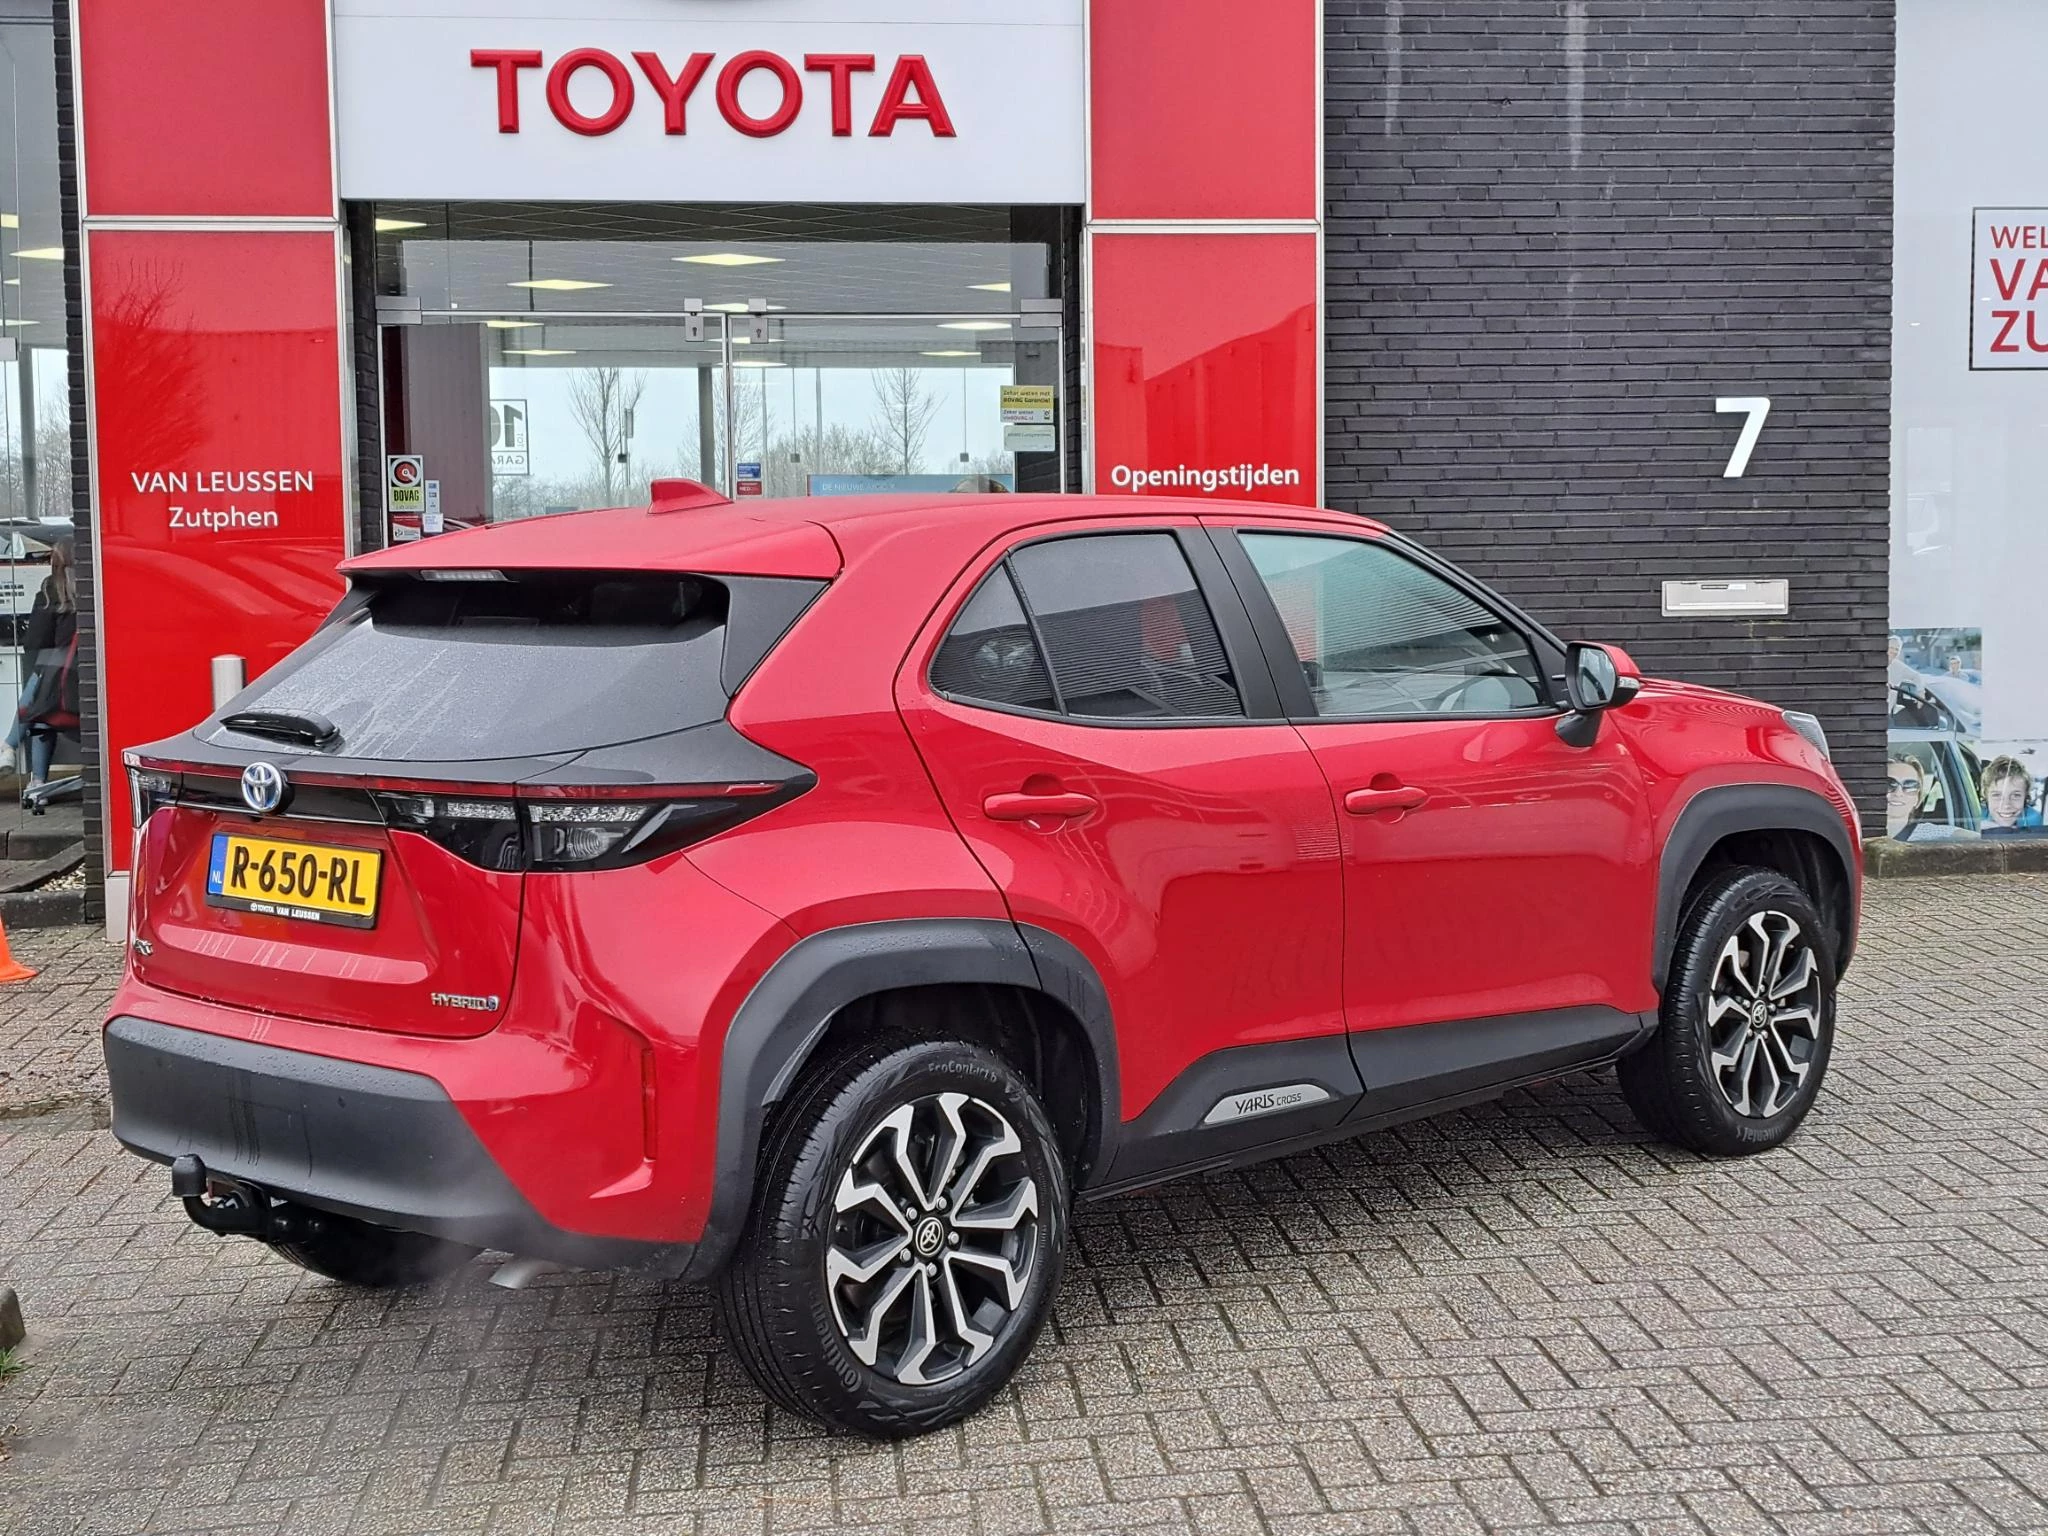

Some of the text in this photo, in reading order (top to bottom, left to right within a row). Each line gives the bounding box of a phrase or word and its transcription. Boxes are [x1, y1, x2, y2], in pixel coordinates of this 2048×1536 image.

[471, 48, 954, 137] TOYOTA
[1715, 396, 1771, 478] 7
[132, 471, 313, 493] VAN LEUSSEN
[1111, 463, 1300, 493] Openingstijden
[393, 489, 420, 502] BOVAG
[168, 506, 278, 532] Zutphen
[212, 871, 222, 884] NL
[231, 845, 366, 906] R-650-RL
[276, 906, 290, 917] VAN
[291, 908, 321, 921] LEUSSEN
[430, 992, 487, 1010] HYBRID
[1234, 1092, 1302, 1115] YARIS CROSS
